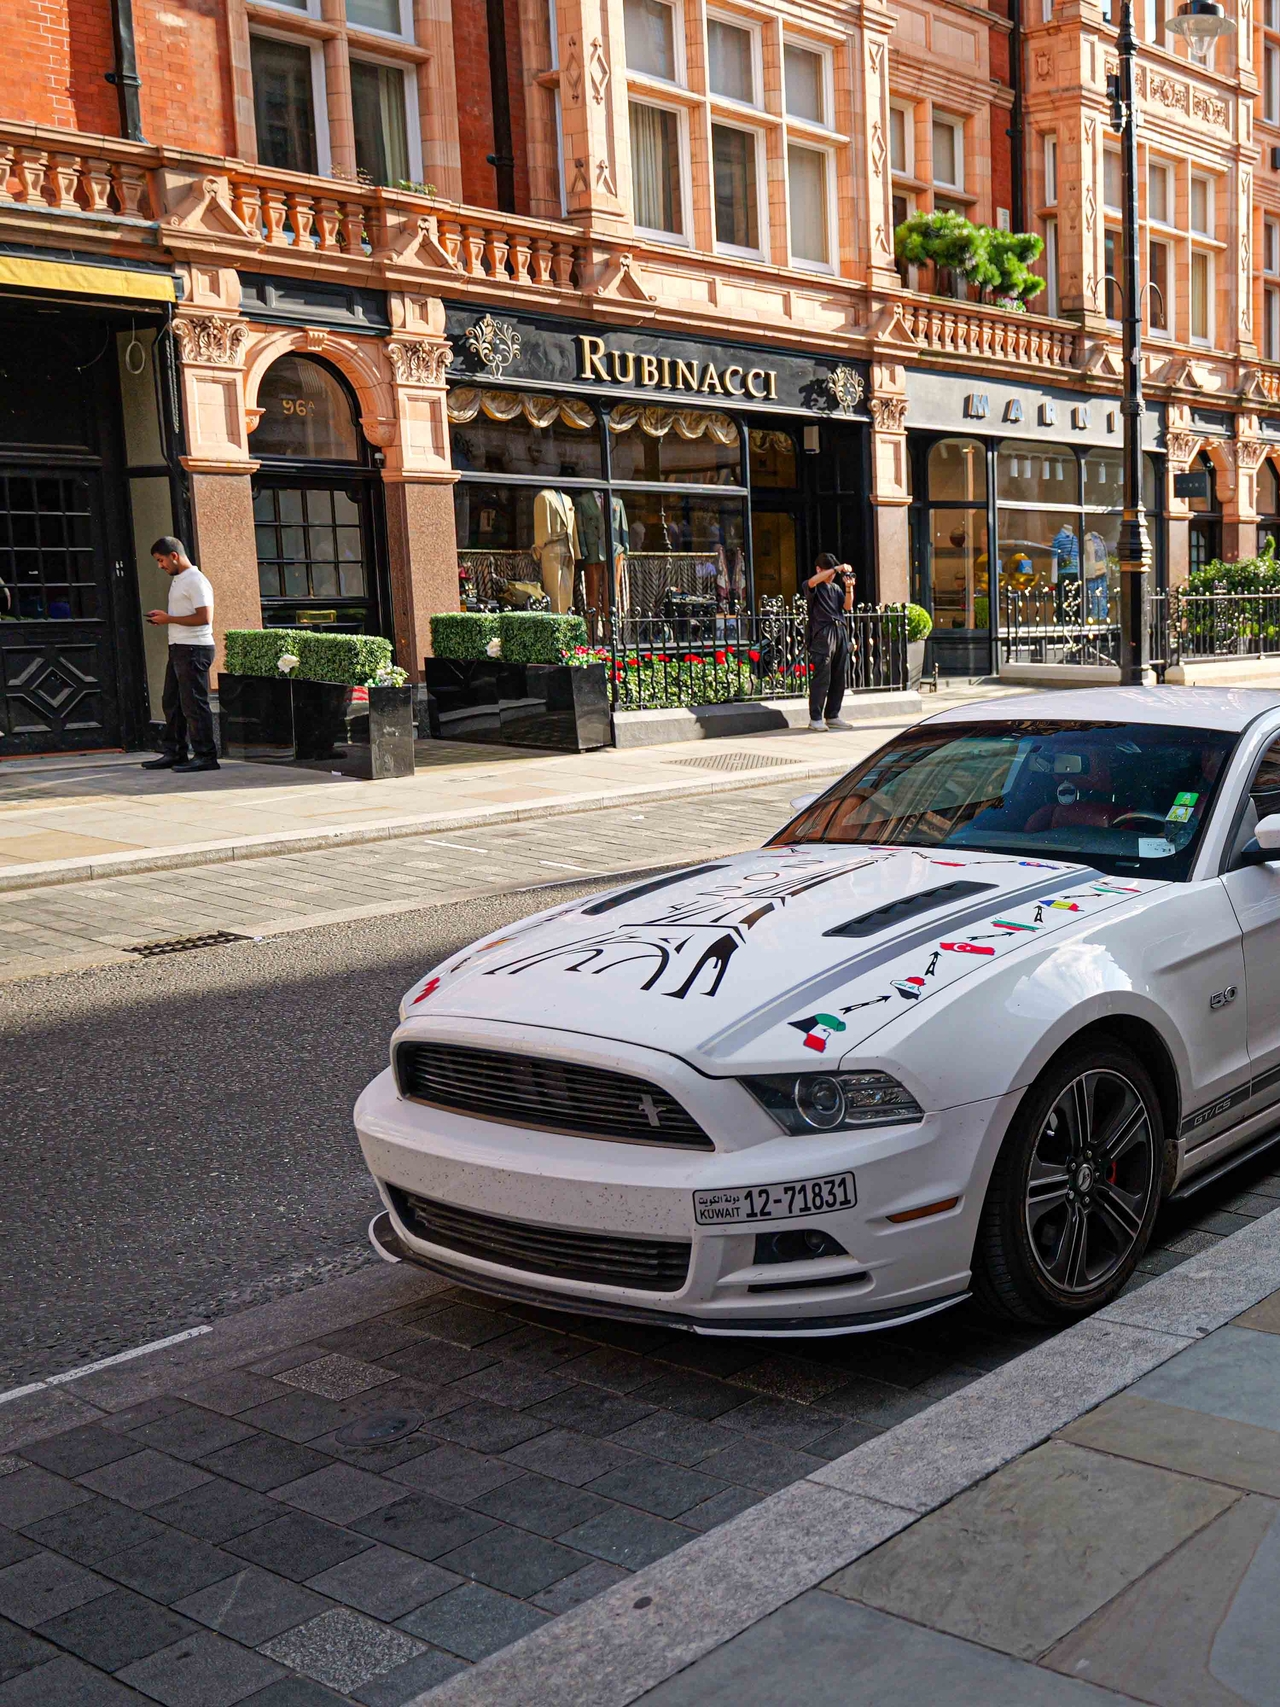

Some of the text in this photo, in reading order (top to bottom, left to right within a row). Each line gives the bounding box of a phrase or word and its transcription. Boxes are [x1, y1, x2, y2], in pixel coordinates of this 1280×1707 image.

[577, 335, 778, 399] RUBINACCI
[968, 393, 1119, 432] MARNI
[1194, 1098, 1232, 1126] GT/CS
[699, 1207, 741, 1220] KUWAIT
[744, 1177, 852, 1219] 12-71831
